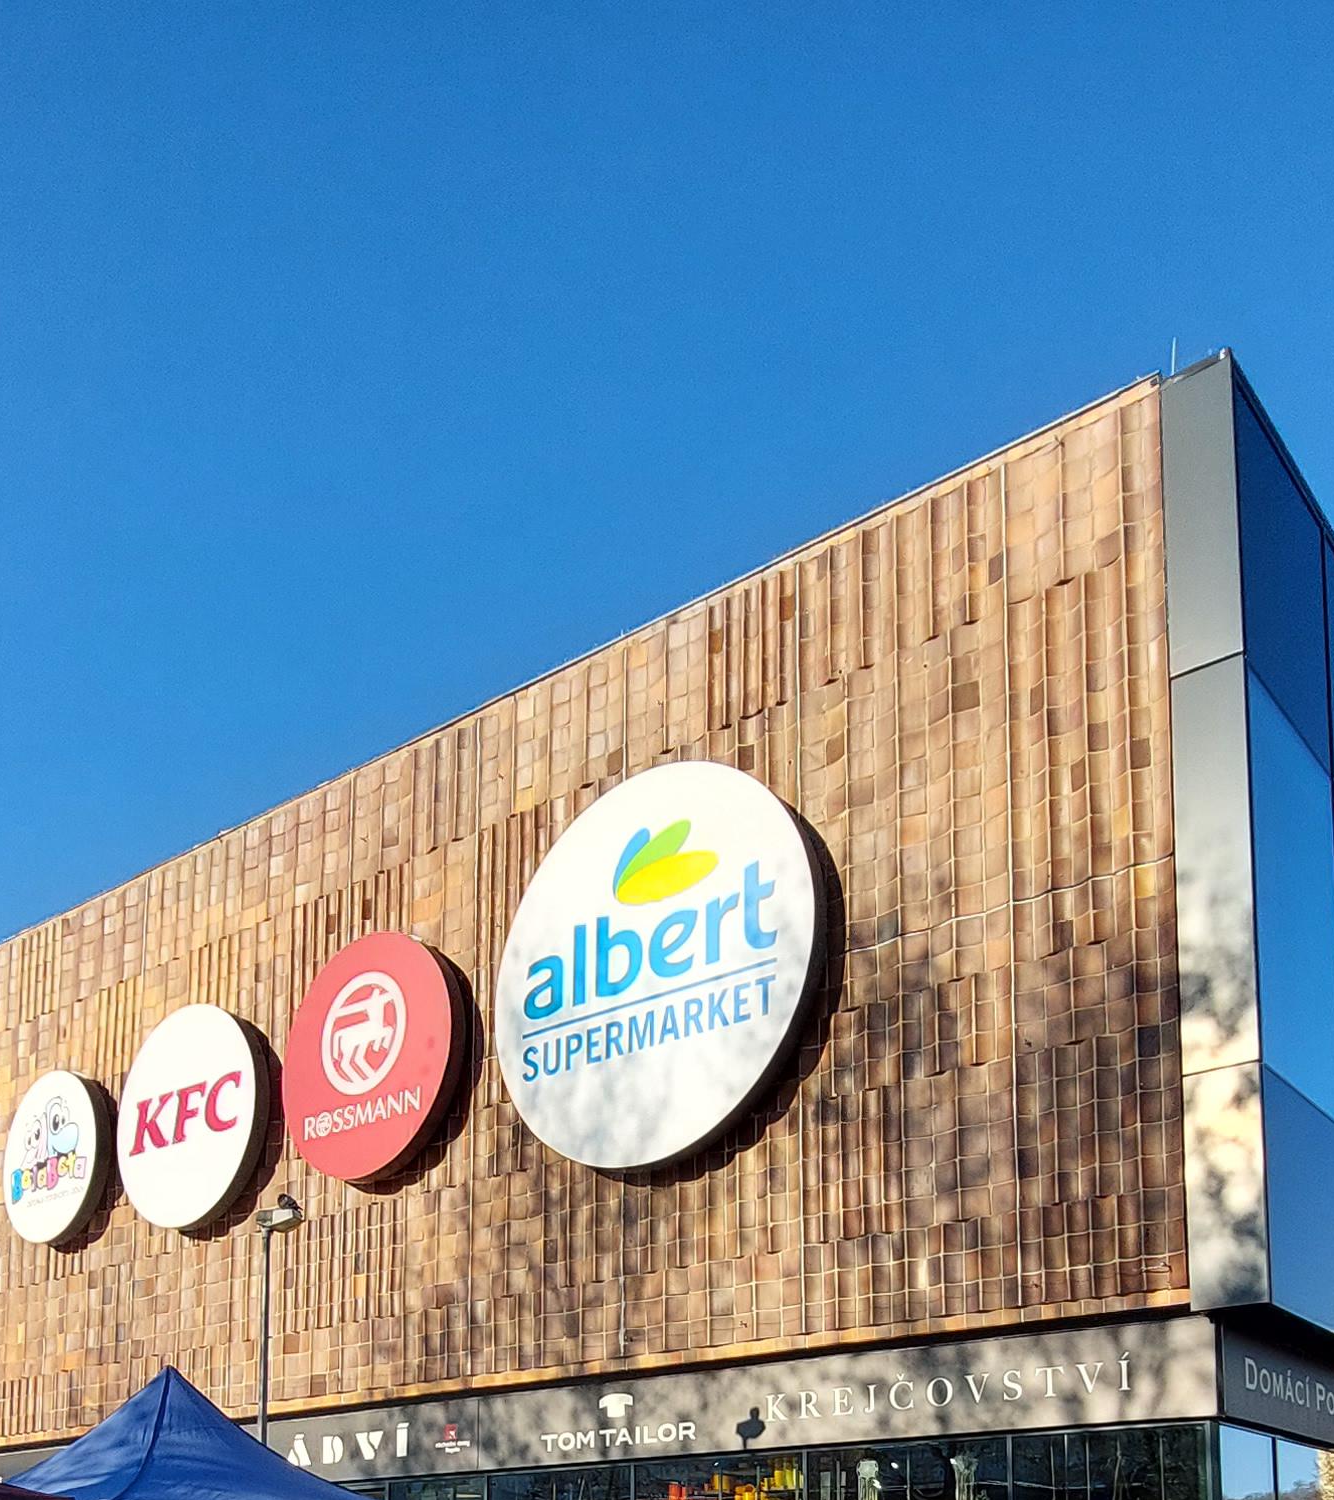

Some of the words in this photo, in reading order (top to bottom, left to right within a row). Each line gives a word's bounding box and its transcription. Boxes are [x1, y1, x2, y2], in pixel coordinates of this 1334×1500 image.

[523, 860, 778, 1020] albert
[522, 974, 776, 1082] SUPERMARKET
[129, 1071, 242, 1157] KFC
[303, 1086, 421, 1141] ROSSMANN
[766, 1352, 1131, 1422] KREJČOVSTVÍ
[287, 1422, 409, 1466] ÁDVÍ
[541, 1431, 595, 1452] TOM
[599, 1421, 696, 1448] TAILOR
